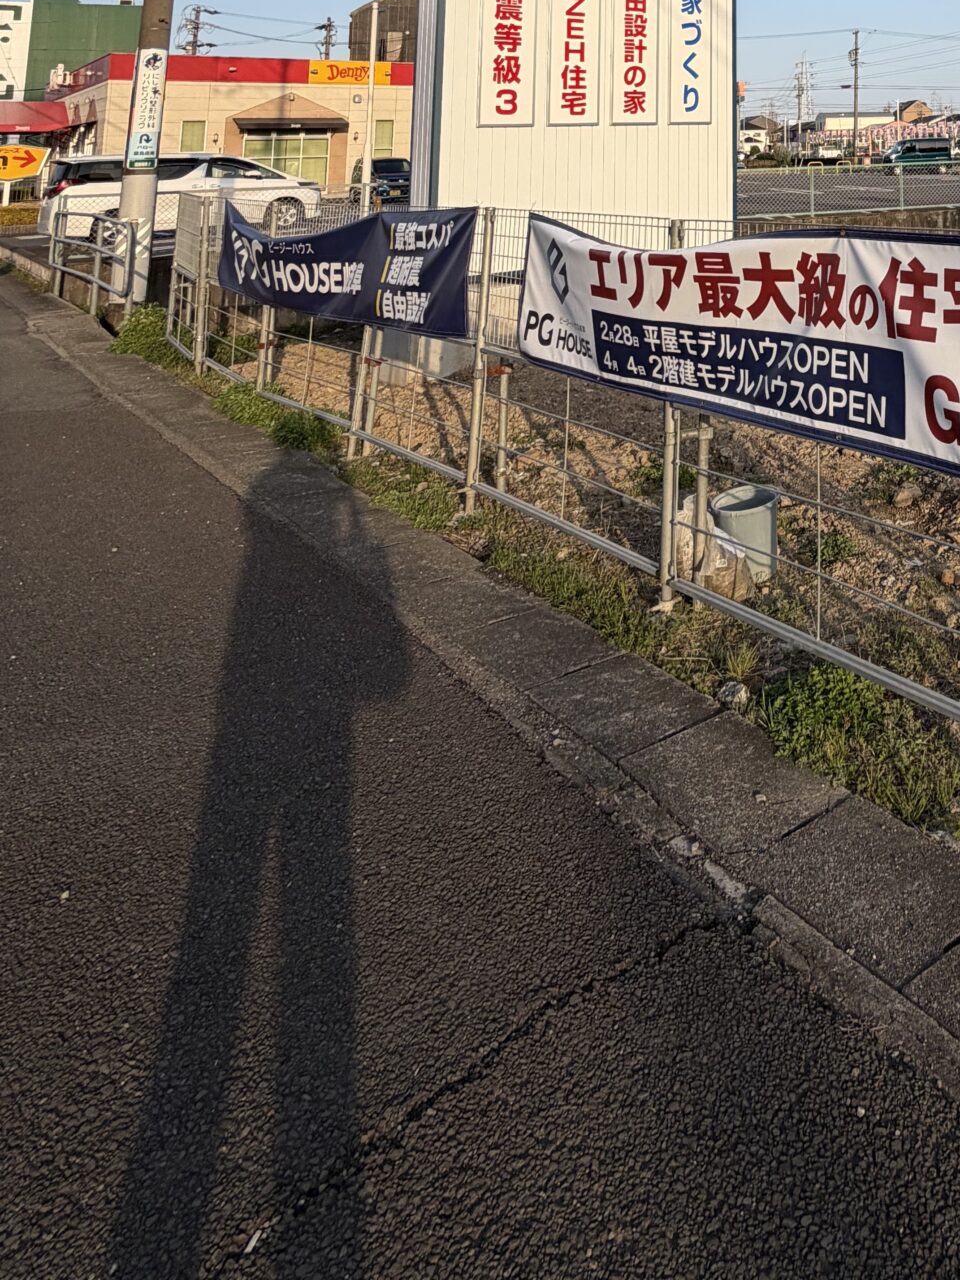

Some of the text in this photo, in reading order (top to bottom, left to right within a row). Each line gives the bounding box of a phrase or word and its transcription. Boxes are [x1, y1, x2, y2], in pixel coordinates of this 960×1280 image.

[326, 64, 371, 81] Denny
[267, 241, 314, 255] ピージーハウス
[394, 220, 454, 251] 最強コスパ
[387, 256, 424, 287] 超耐震
[382, 290, 431, 324] 自由設計
[524, 310, 555, 346] PG
[556, 328, 593, 359] HOUSE
[642, 325, 869, 384] 平屋モデルハウスOPEN
[649, 355, 887, 428] 2階建モデルハウスOPEN
